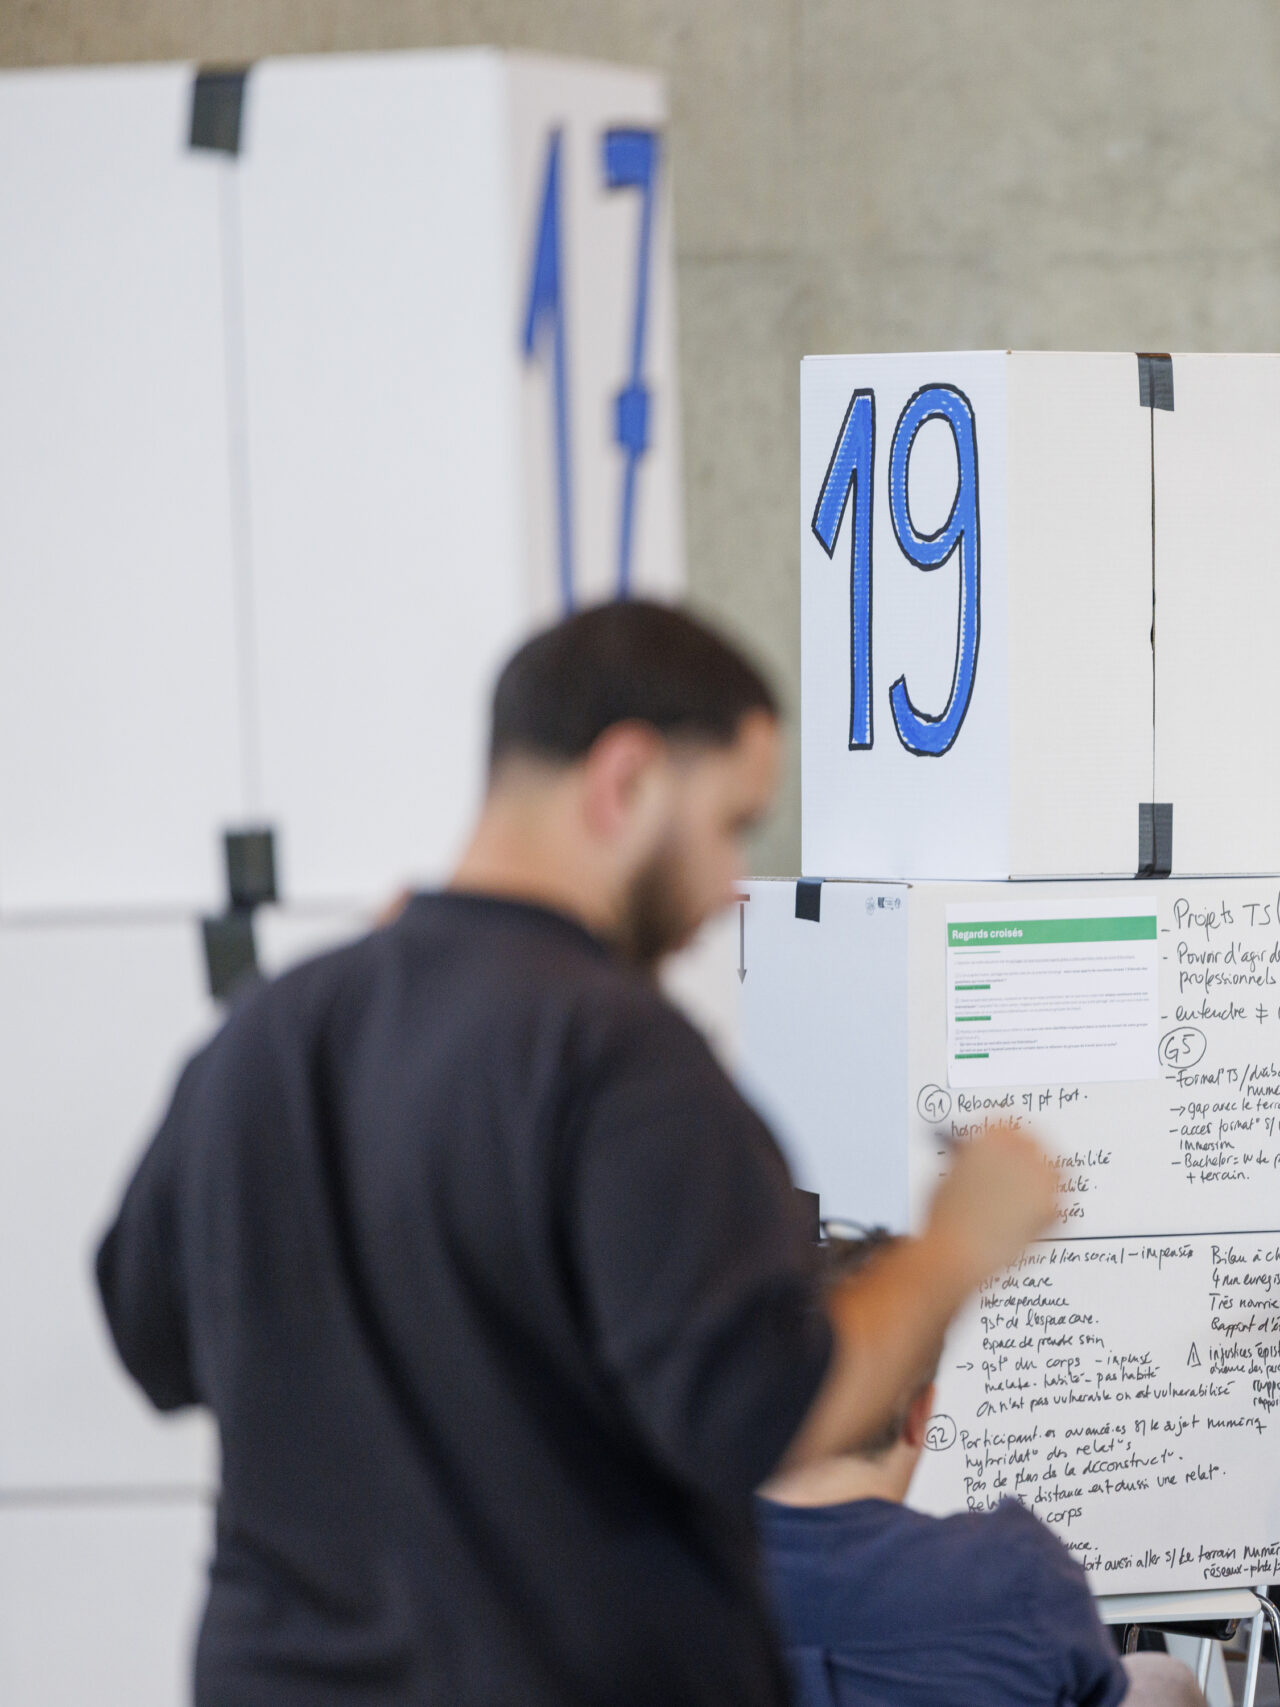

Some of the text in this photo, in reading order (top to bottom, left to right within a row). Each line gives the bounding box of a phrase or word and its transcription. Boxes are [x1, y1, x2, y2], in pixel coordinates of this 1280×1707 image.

[811, 383, 980, 757] 19
[1174, 898, 1271, 942] Projets TS
[952, 928, 1023, 941] Regards croisés
[957, 1092, 1015, 1113] Rebonds
[1188, 1102, 1210, 1120] gap
[1046, 1357, 1081, 1376] corps
[1046, 1506, 1082, 1527] corps
